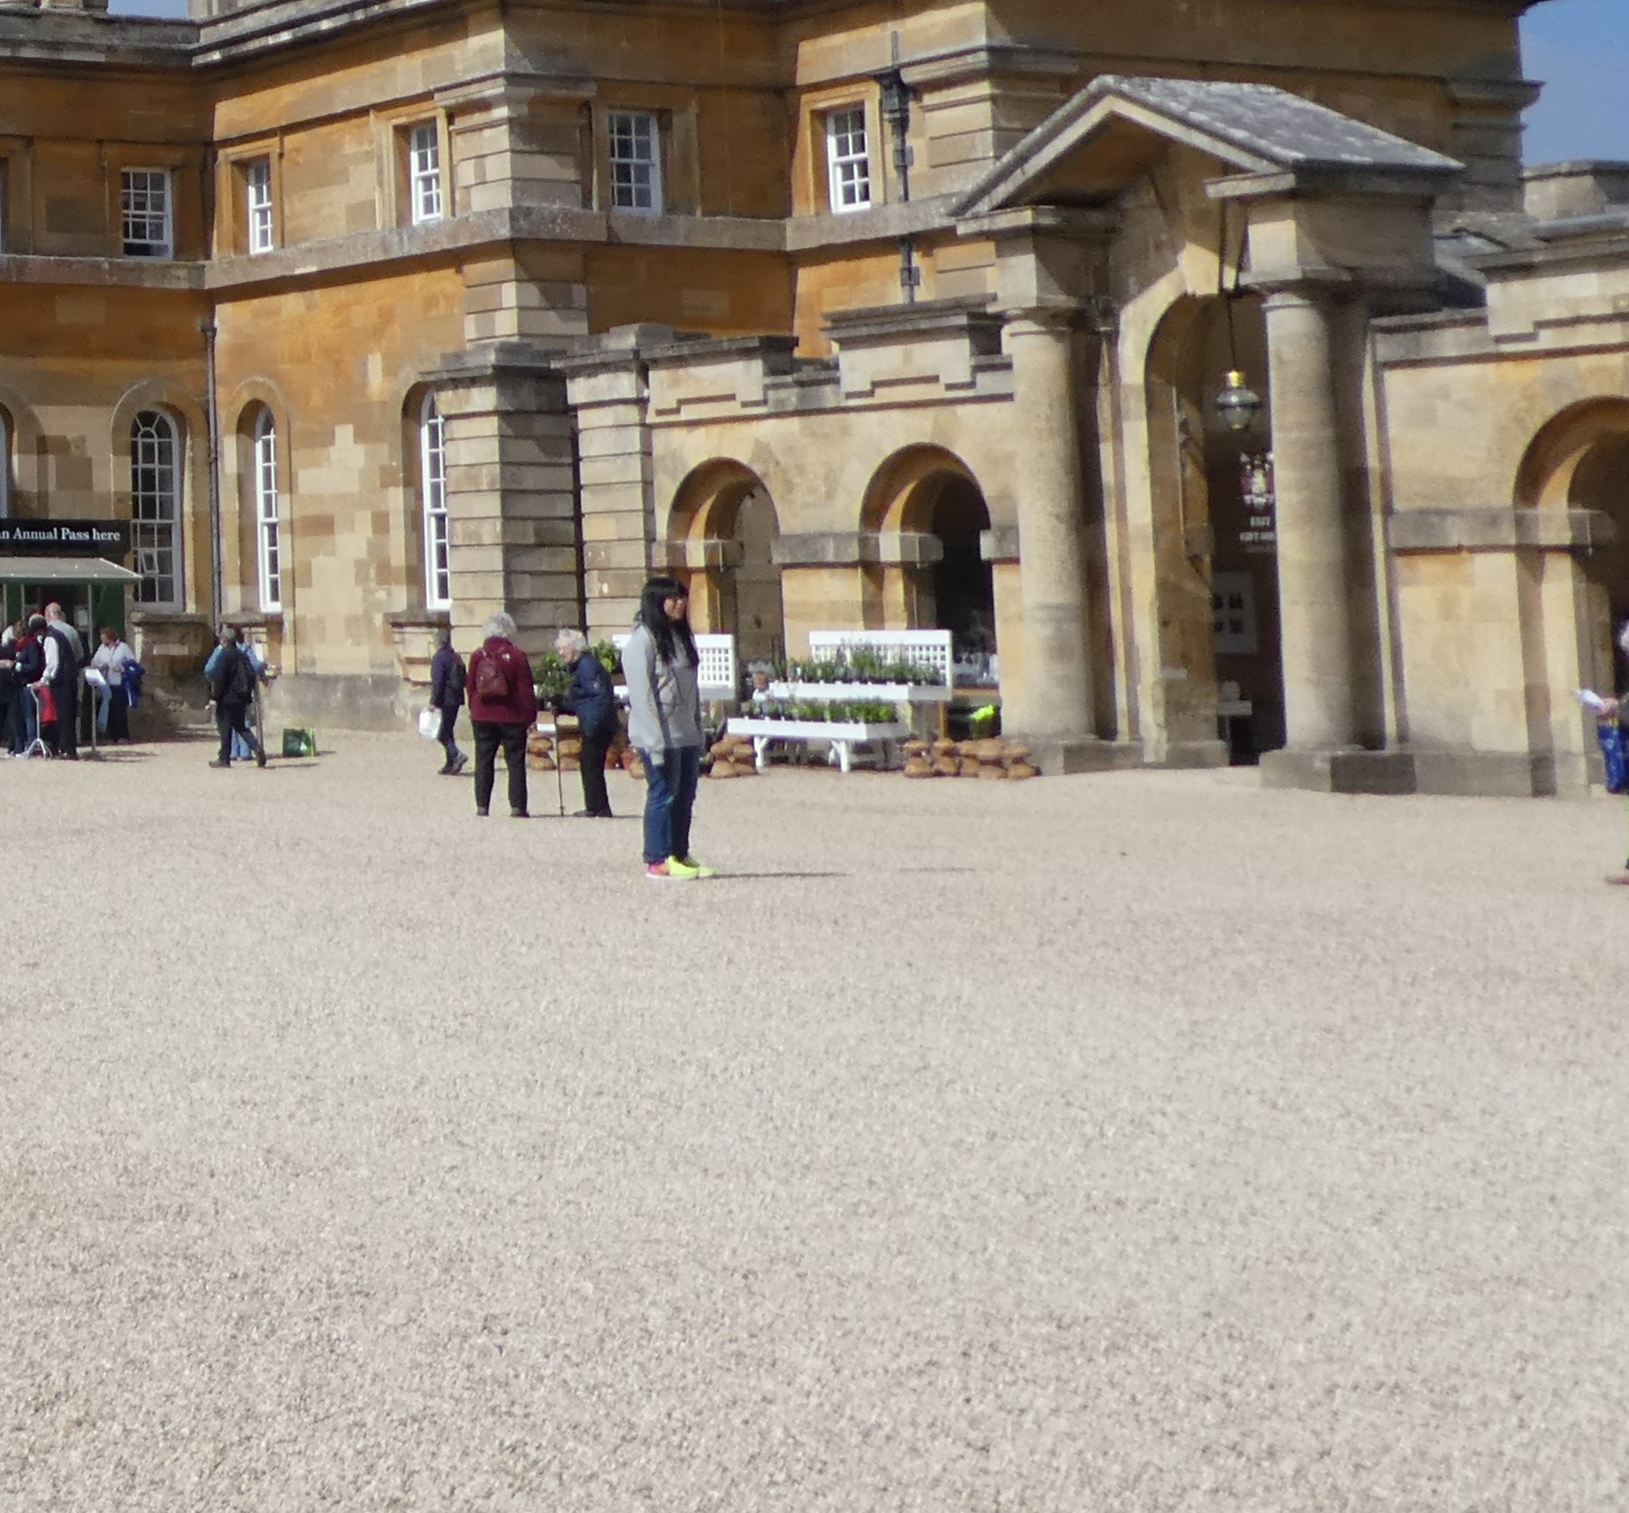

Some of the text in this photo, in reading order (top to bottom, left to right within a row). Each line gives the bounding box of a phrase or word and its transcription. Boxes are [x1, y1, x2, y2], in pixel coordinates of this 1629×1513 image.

[13, 527, 58, 540] Annual
[60, 527, 90, 541] Pass
[92, 528, 121, 541] here
